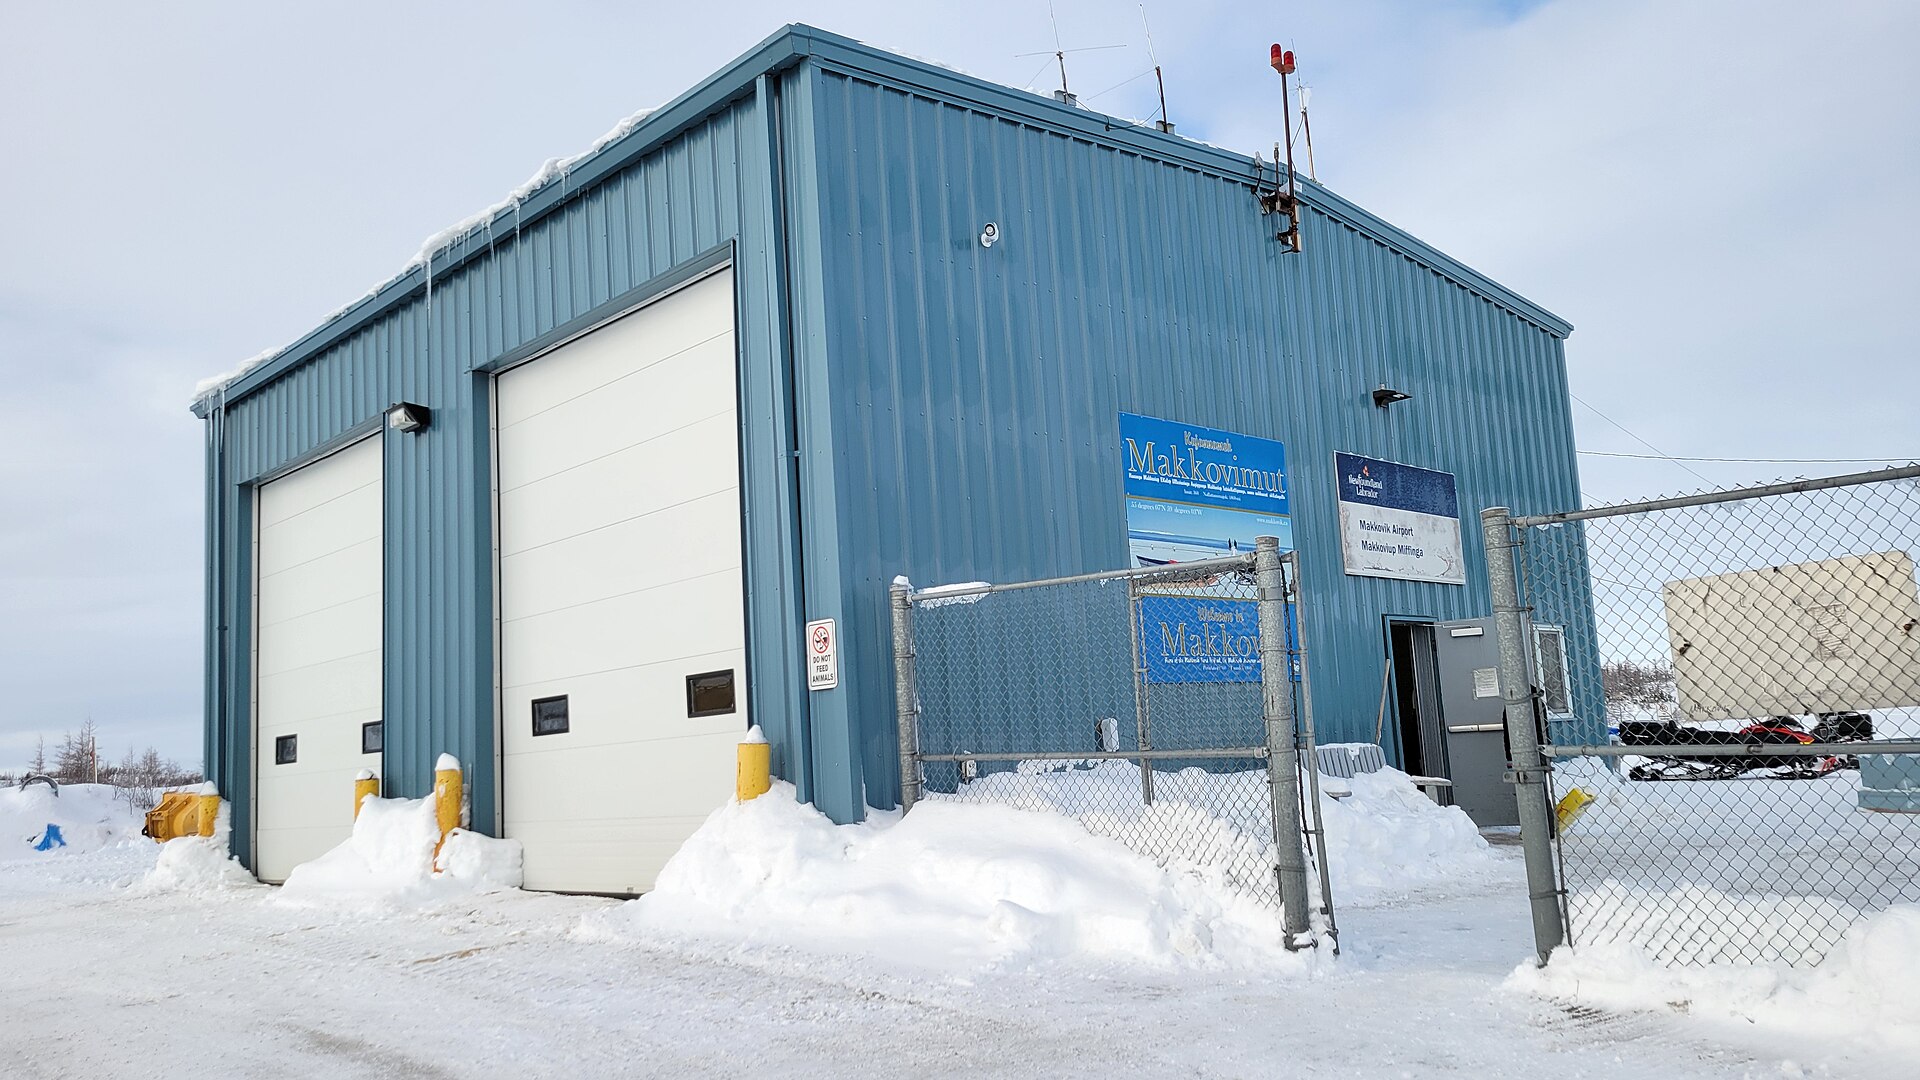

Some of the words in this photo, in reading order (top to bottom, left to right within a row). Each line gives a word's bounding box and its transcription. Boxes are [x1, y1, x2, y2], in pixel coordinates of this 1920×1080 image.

[1126, 438, 1287, 494] Makkovimut
[1356, 486, 1378, 499] Labrador
[1359, 520, 1391, 534] Makkovik
[1392, 524, 1414, 537] Airport
[1160, 622, 1262, 657] Makkov
[813, 656, 820, 664] DO
[820, 654, 831, 663] NOT
[816, 665, 828, 673] FEED
[812, 673, 833, 682] ANIMALS
